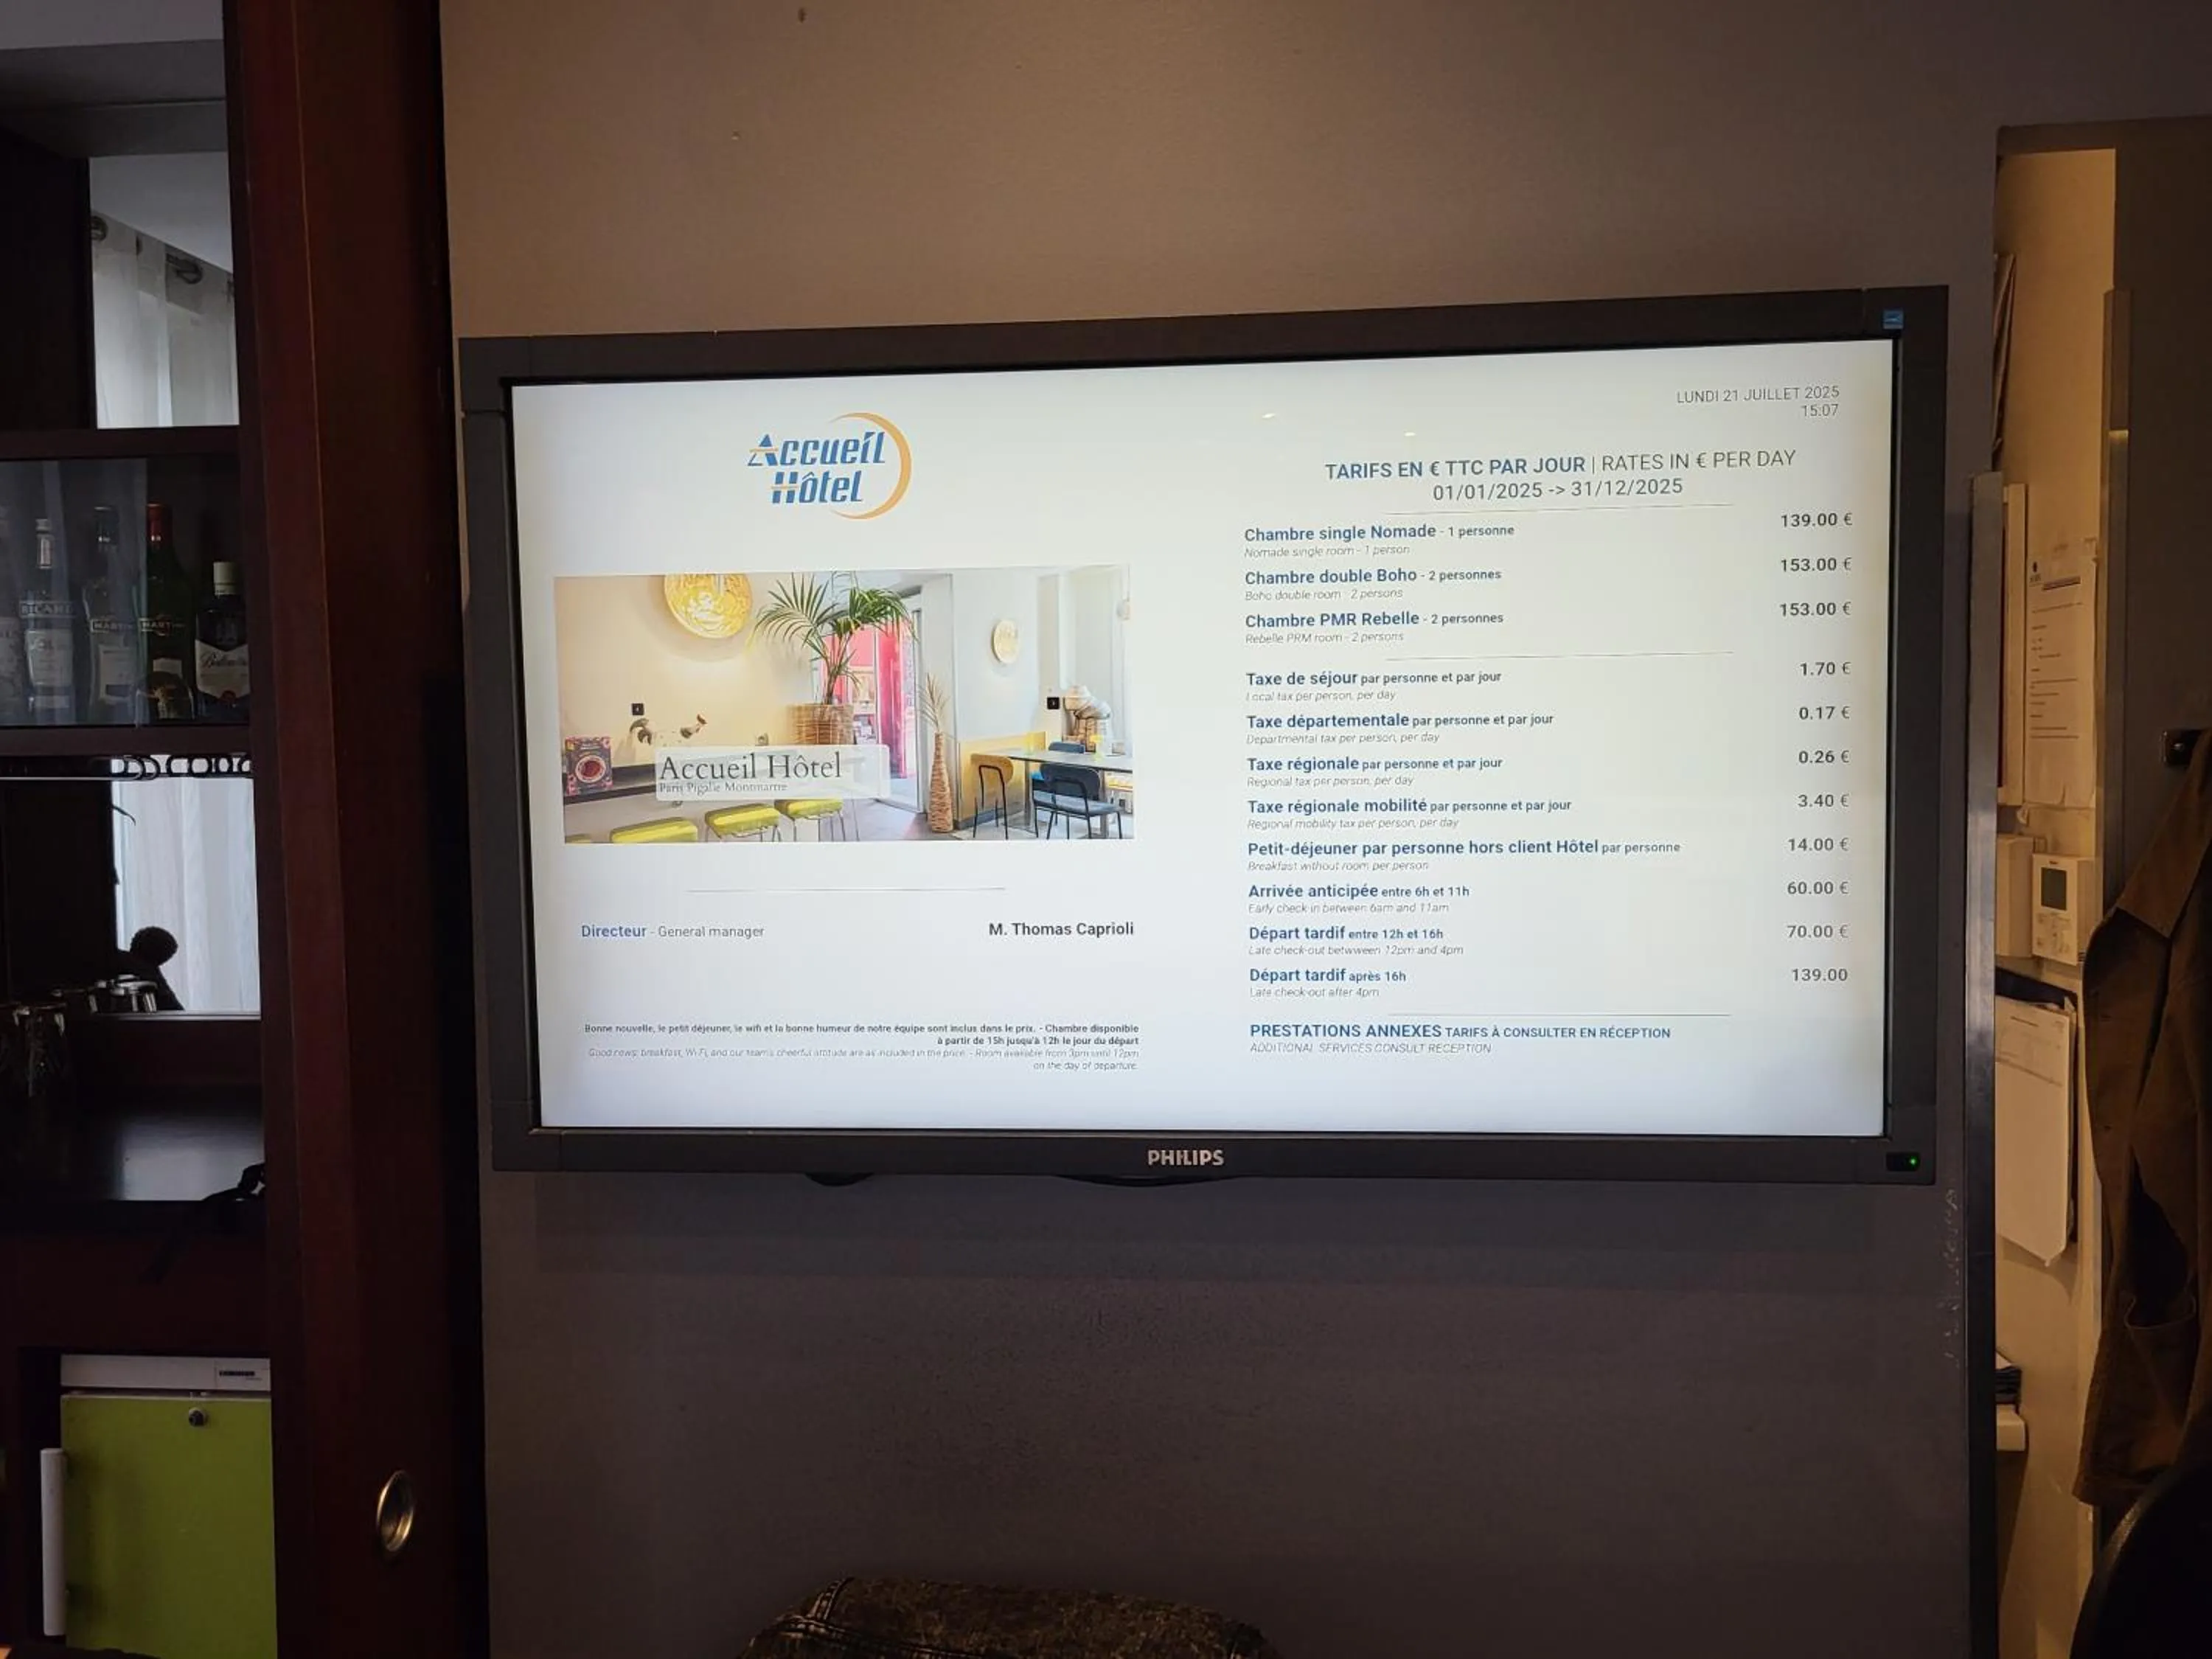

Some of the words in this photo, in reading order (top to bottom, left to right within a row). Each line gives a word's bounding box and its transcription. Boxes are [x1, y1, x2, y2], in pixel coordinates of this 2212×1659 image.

[1677, 389, 1719, 403] LUNDI
[1722, 389, 1738, 402] 21
[1743, 387, 1801, 401] JUILLET
[1804, 385, 1840, 400] 2025
[1801, 403, 1839, 417] 15:07
[748, 431, 886, 466] Accueil
[1325, 462, 1393, 480] TARIFS
[1398, 461, 1423, 477] EN
[1429, 461, 1440, 477] €
[1444, 459, 1484, 476] TTC
[1489, 458, 1528, 475] PAR
[1533, 456, 1586, 473] JOUR
[1601, 453, 1664, 471] RATES
[1670, 453, 1689, 470] IN
[1696, 452, 1707, 467] €
[1713, 451, 1751, 468] PER
[1757, 450, 1796, 467] DAY
[771, 470, 863, 504] Hôtel
[1433, 482, 1543, 501] 01/01/2025
[1571, 478, 1683, 496] 31/12/2025
[1781, 512, 1838, 528] 139.00
[1843, 512, 1853, 526] €
[1244, 527, 1315, 542] Chambre
[1319, 525, 1366, 543] single
[1371, 524, 1437, 539] Nomade
[1448, 526, 1453, 537] 1
[1458, 527, 1514, 539] personne
[1781, 557, 1837, 572] 153.00
[1843, 557, 1851, 570] €
[1245, 570, 1315, 585] Chambre
[1318, 568, 1373, 583] double
[1377, 567, 1417, 582] Boho
[1428, 571, 1436, 581] 2
[1439, 571, 1501, 582] personnes
[1780, 602, 1837, 617] 153.00
[1842, 602, 1851, 615] €
[1245, 613, 1316, 628] Chambre
[1320, 613, 1357, 627] PMR
[1361, 611, 1420, 626] Rebelle
[1431, 614, 1438, 625] 2
[1441, 615, 1503, 626] personnes
[1800, 661, 1836, 676] 1.70
[1841, 662, 1851, 674] €
[1245, 672, 1283, 686] Taxe
[1286, 671, 1306, 685] de
[1310, 670, 1359, 688] séjour
[1360, 675, 1380, 686] par
[1382, 675, 1439, 686] personne
[1441, 672, 1453, 682] et
[1455, 673, 1475, 684] par
[1478, 673, 1502, 685] jour
[1798, 706, 1836, 720] 0.17
[1840, 706, 1850, 719] €
[1246, 715, 1283, 729] Taxe
[1286, 712, 1410, 731] départementale
[1412, 717, 1433, 728] par
[1434, 717, 1490, 728] personne
[1493, 715, 1505, 725] et
[1508, 716, 1528, 728] par
[1530, 714, 1554, 727] jour
[1247, 757, 1284, 771] Taxe
[1287, 756, 1360, 773] régionale
[1362, 761, 1381, 772] par
[1384, 760, 1439, 771] personne
[1442, 759, 1454, 768] et
[1457, 760, 1477, 771] par
[1478, 757, 1503, 771] jour
[1798, 750, 1835, 764] 0.26
[1840, 750, 1849, 762] €
[660, 751, 757, 780] Accueil
[767, 751, 842, 779] Hôtel
[659, 782, 684, 793] Paris
[686, 782, 720, 798] Pigalle
[724, 781, 788, 793] Montmartre
[1247, 800, 1284, 813] Taxe
[1287, 799, 1360, 816] régionale
[1364, 798, 1428, 812] mobilité
[1430, 803, 1450, 814] par
[1452, 802, 1508, 814] personne
[1511, 801, 1523, 810] et
[1526, 801, 1545, 813] par
[1548, 801, 1571, 813] jour
[1798, 794, 1834, 807] 3.40
[1840, 794, 1848, 807] €
[1247, 818, 1293, 830] Regional
[1295, 818, 1337, 830] mobility
[1339, 818, 1356, 828] tax
[1357, 819, 1377, 830] per
[1419, 818, 1438, 829] per
[1439, 817, 1459, 829] day
[1248, 841, 1358, 858] Petit-déjeuner
[1362, 844, 1388, 858] par
[1391, 844, 1465, 858] personne
[1469, 840, 1504, 854] hors
[1508, 839, 1552, 853] client
[1557, 839, 1599, 853] Hôtel
[1601, 845, 1621, 855] par
[1624, 844, 1680, 855] personne
[1788, 837, 1834, 852] 14.00
[1839, 837, 1848, 850] €
[1248, 885, 1304, 897] Arrivée
[1307, 883, 1379, 900] anticipée
[1381, 887, 1412, 897] entre
[1414, 886, 1430, 897] 6h
[1433, 887, 1444, 897] et
[1447, 886, 1470, 897] 11h
[1787, 882, 1834, 894] 60.00
[1839, 881, 1848, 894] €
[581, 924, 647, 937] Directeur
[658, 925, 706, 937] General
[709, 928, 765, 940] manager
[989, 922, 1008, 936] M.
[1010, 922, 1073, 936] Thomas
[1076, 921, 1134, 938] Caprioli
[1249, 926, 1301, 943] Départ
[1304, 926, 1346, 940] tardif
[1348, 929, 1379, 939] entre
[1382, 928, 1404, 939] 12h
[1406, 928, 1419, 939] et
[1422, 928, 1444, 939] 16h
[1787, 925, 1834, 939] 70.00
[1839, 925, 1847, 937] €
[1250, 968, 1301, 984] Départ
[1304, 968, 1347, 982] tardif
[1349, 972, 1381, 984] après
[1385, 970, 1406, 981] 16h
[1792, 968, 1848, 981] 139.00
[1250, 988, 1272, 998] Late
[1274, 986, 1326, 998] check-out
[1328, 986, 1354, 997] after
[1355, 987, 1380, 998] 4pm
[1250, 1023, 1361, 1037] PRESTATIONS
[1365, 1024, 1442, 1037] ANNEXES
[1444, 1027, 1489, 1037] TARIFS
[1492, 1025, 1500, 1037] À
[1503, 1027, 1576, 1037] CONSULTER
[1579, 1027, 1596, 1037] EN
[1599, 1026, 1671, 1039] RÉCEPTION
[937, 1036, 943, 1045] à
[945, 1036, 970, 1046] partir
[973, 1036, 984, 1045] de
[987, 1036, 1005, 1045] 15h
[1043, 1036, 1060, 1045] 12h
[1062, 1036, 1071, 1045] le
[1072, 1036, 1091, 1046] jour
[1093, 1036, 1106, 1045] du
[1107, 1035, 1139, 1047] départ
[1148, 1150, 1225, 1166] PHILIPS
